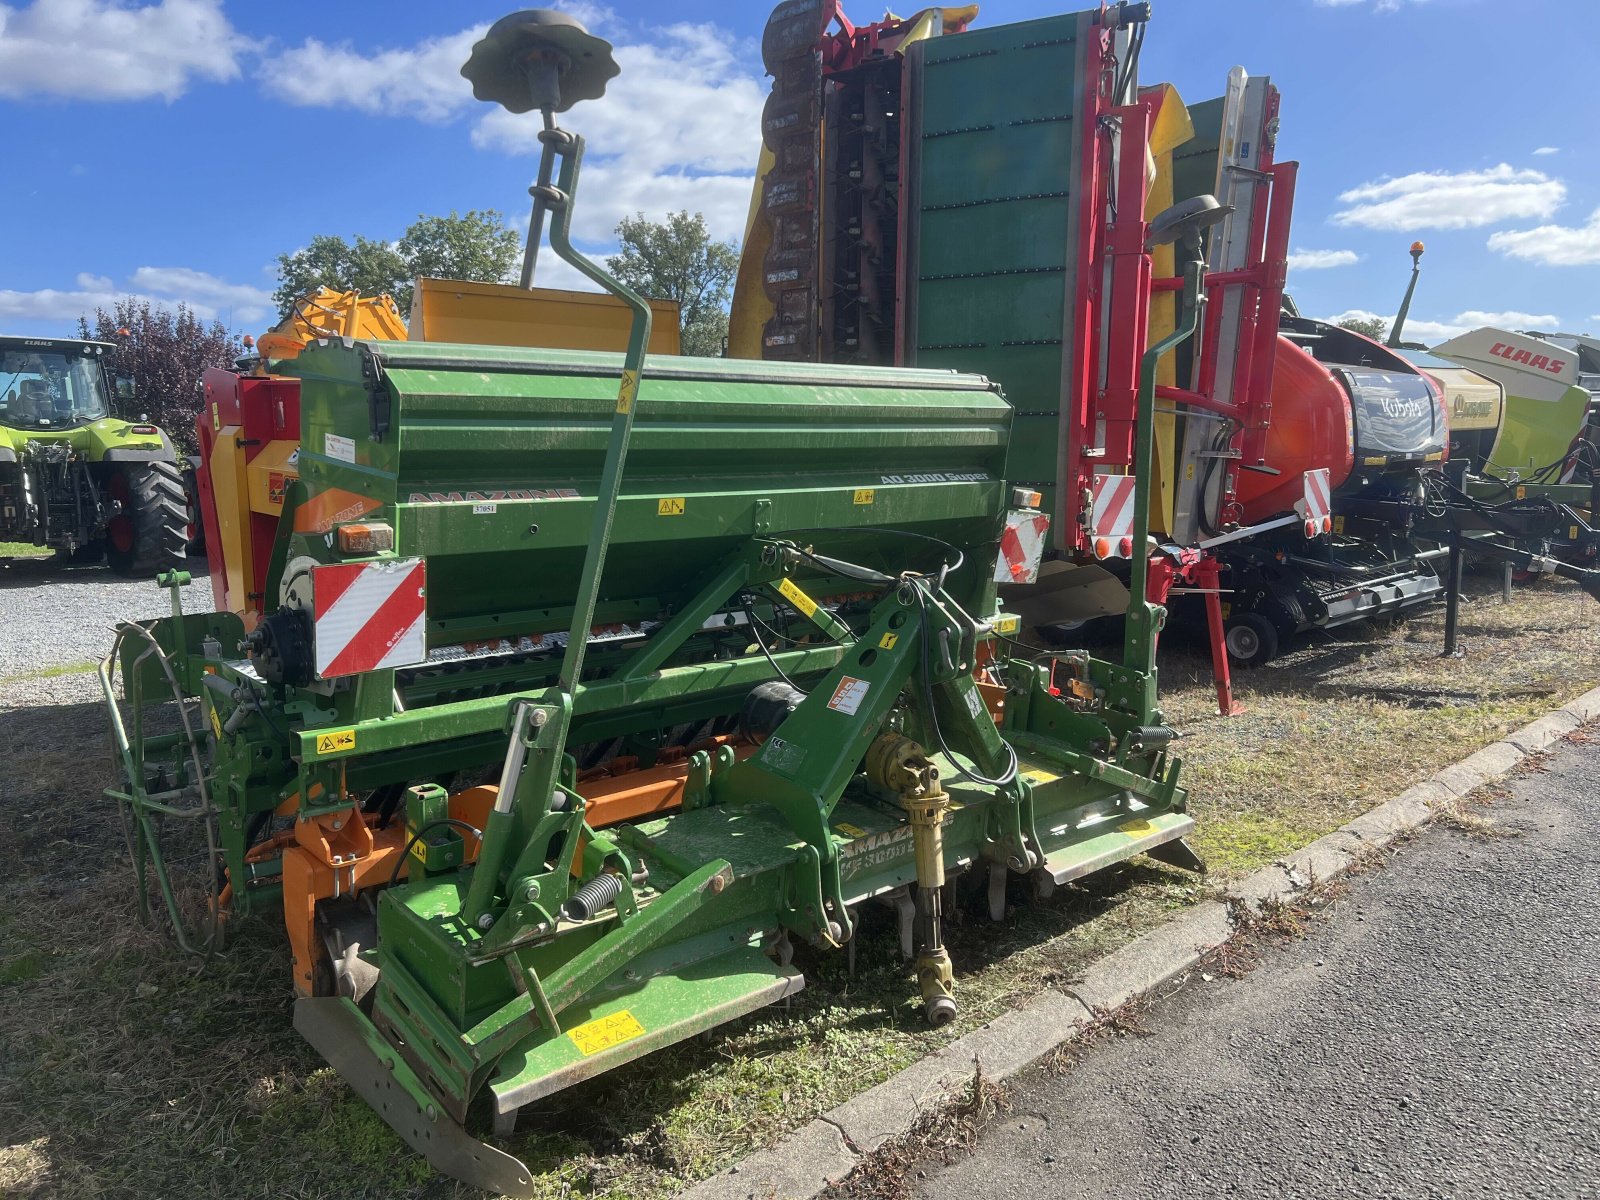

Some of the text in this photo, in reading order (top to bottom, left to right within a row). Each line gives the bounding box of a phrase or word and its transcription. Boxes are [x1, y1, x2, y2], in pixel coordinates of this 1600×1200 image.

[1489, 342, 1566, 374] CLAAS
[1380, 398, 1422, 418] Kubota
[904, 473, 946, 484] 3000
[945, 472, 990, 482] Super
[408, 488, 582, 505] AMAZONE
